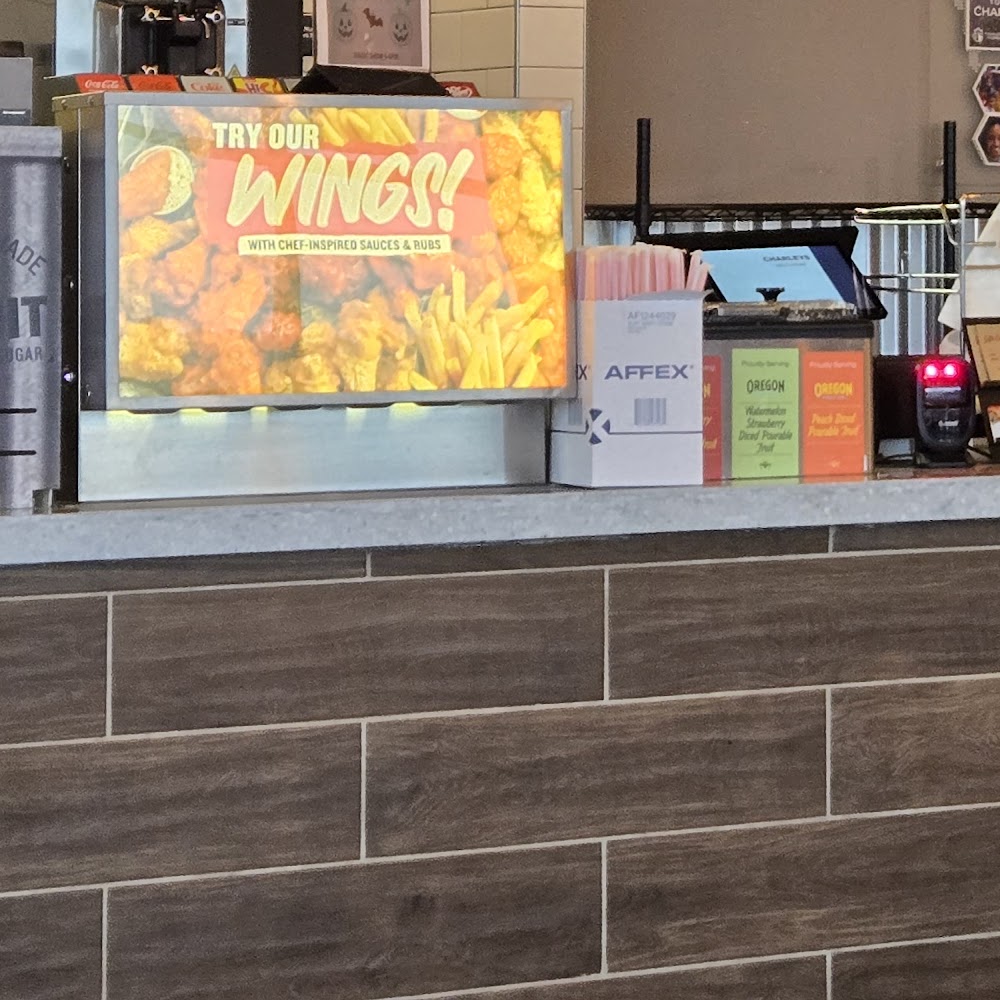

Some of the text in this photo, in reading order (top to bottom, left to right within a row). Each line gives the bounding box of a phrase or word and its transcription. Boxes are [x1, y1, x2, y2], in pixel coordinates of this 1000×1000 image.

[212, 122, 320, 150] TRY OUR
[226, 148, 475, 232] WINGS!
[248, 239, 441, 251] WITH CHEF-INSPIRED SAUCES & RUBS
[604, 364, 689, 380] AFFEX
[746, 379, 785, 394] OREGON
[814, 382, 853, 397] OREGON
